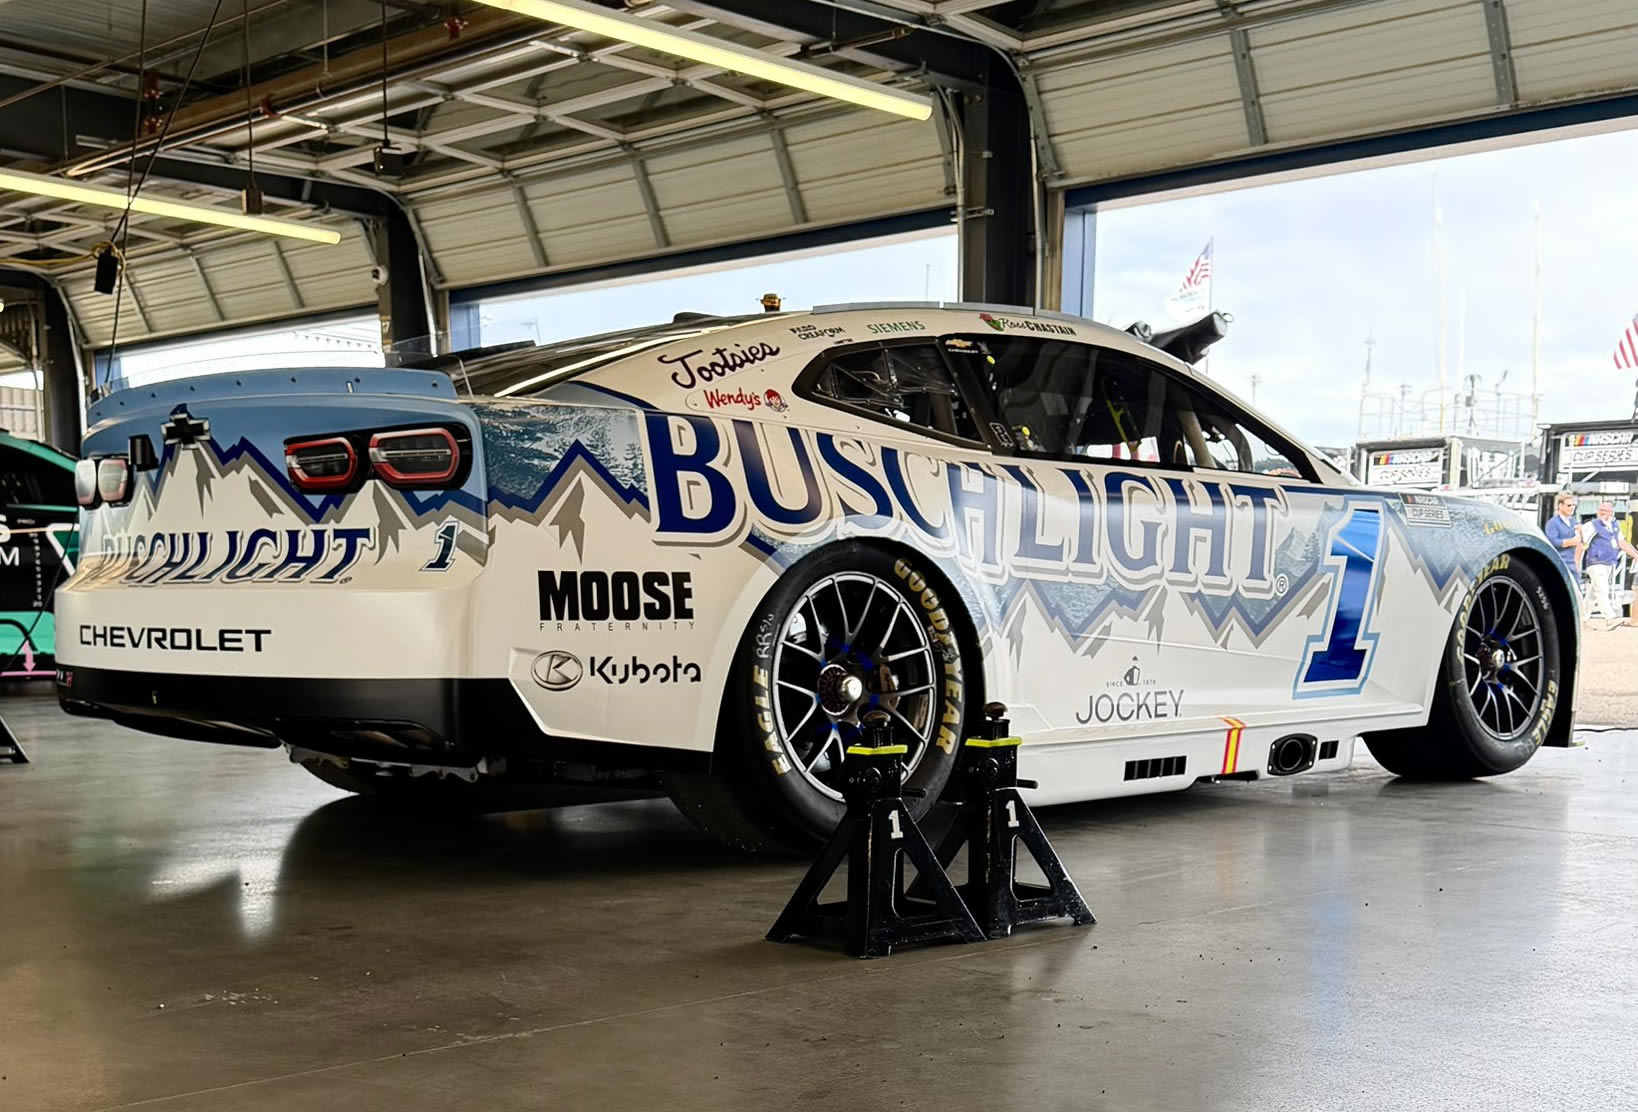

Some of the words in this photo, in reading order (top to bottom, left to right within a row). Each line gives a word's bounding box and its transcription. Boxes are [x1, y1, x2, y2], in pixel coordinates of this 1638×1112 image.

[866, 320, 926, 334] SIEMENS
[1024, 320, 1077, 337] CHASTAIN
[657, 342, 780, 389] Tootsies
[703, 387, 762, 411] Wendy's
[1412, 508, 1424, 518] CUP
[1424, 509, 1444, 519] SERIES
[420, 521, 459, 572] 1
[538, 570, 694, 621] MOOSE
[1297, 499, 1381, 693] 1
[79, 624, 272, 652] CHEVROLET
[539, 622, 695, 632] FRATERNITY
[589, 655, 702, 684] Kubota
[1105, 680, 1123, 688] SINCE
[753, 664, 792, 775] EAGLE
[1076, 689, 1184, 724] JOCKEY
[888, 810, 904, 839] 1
[1005, 800, 1020, 828] 1
